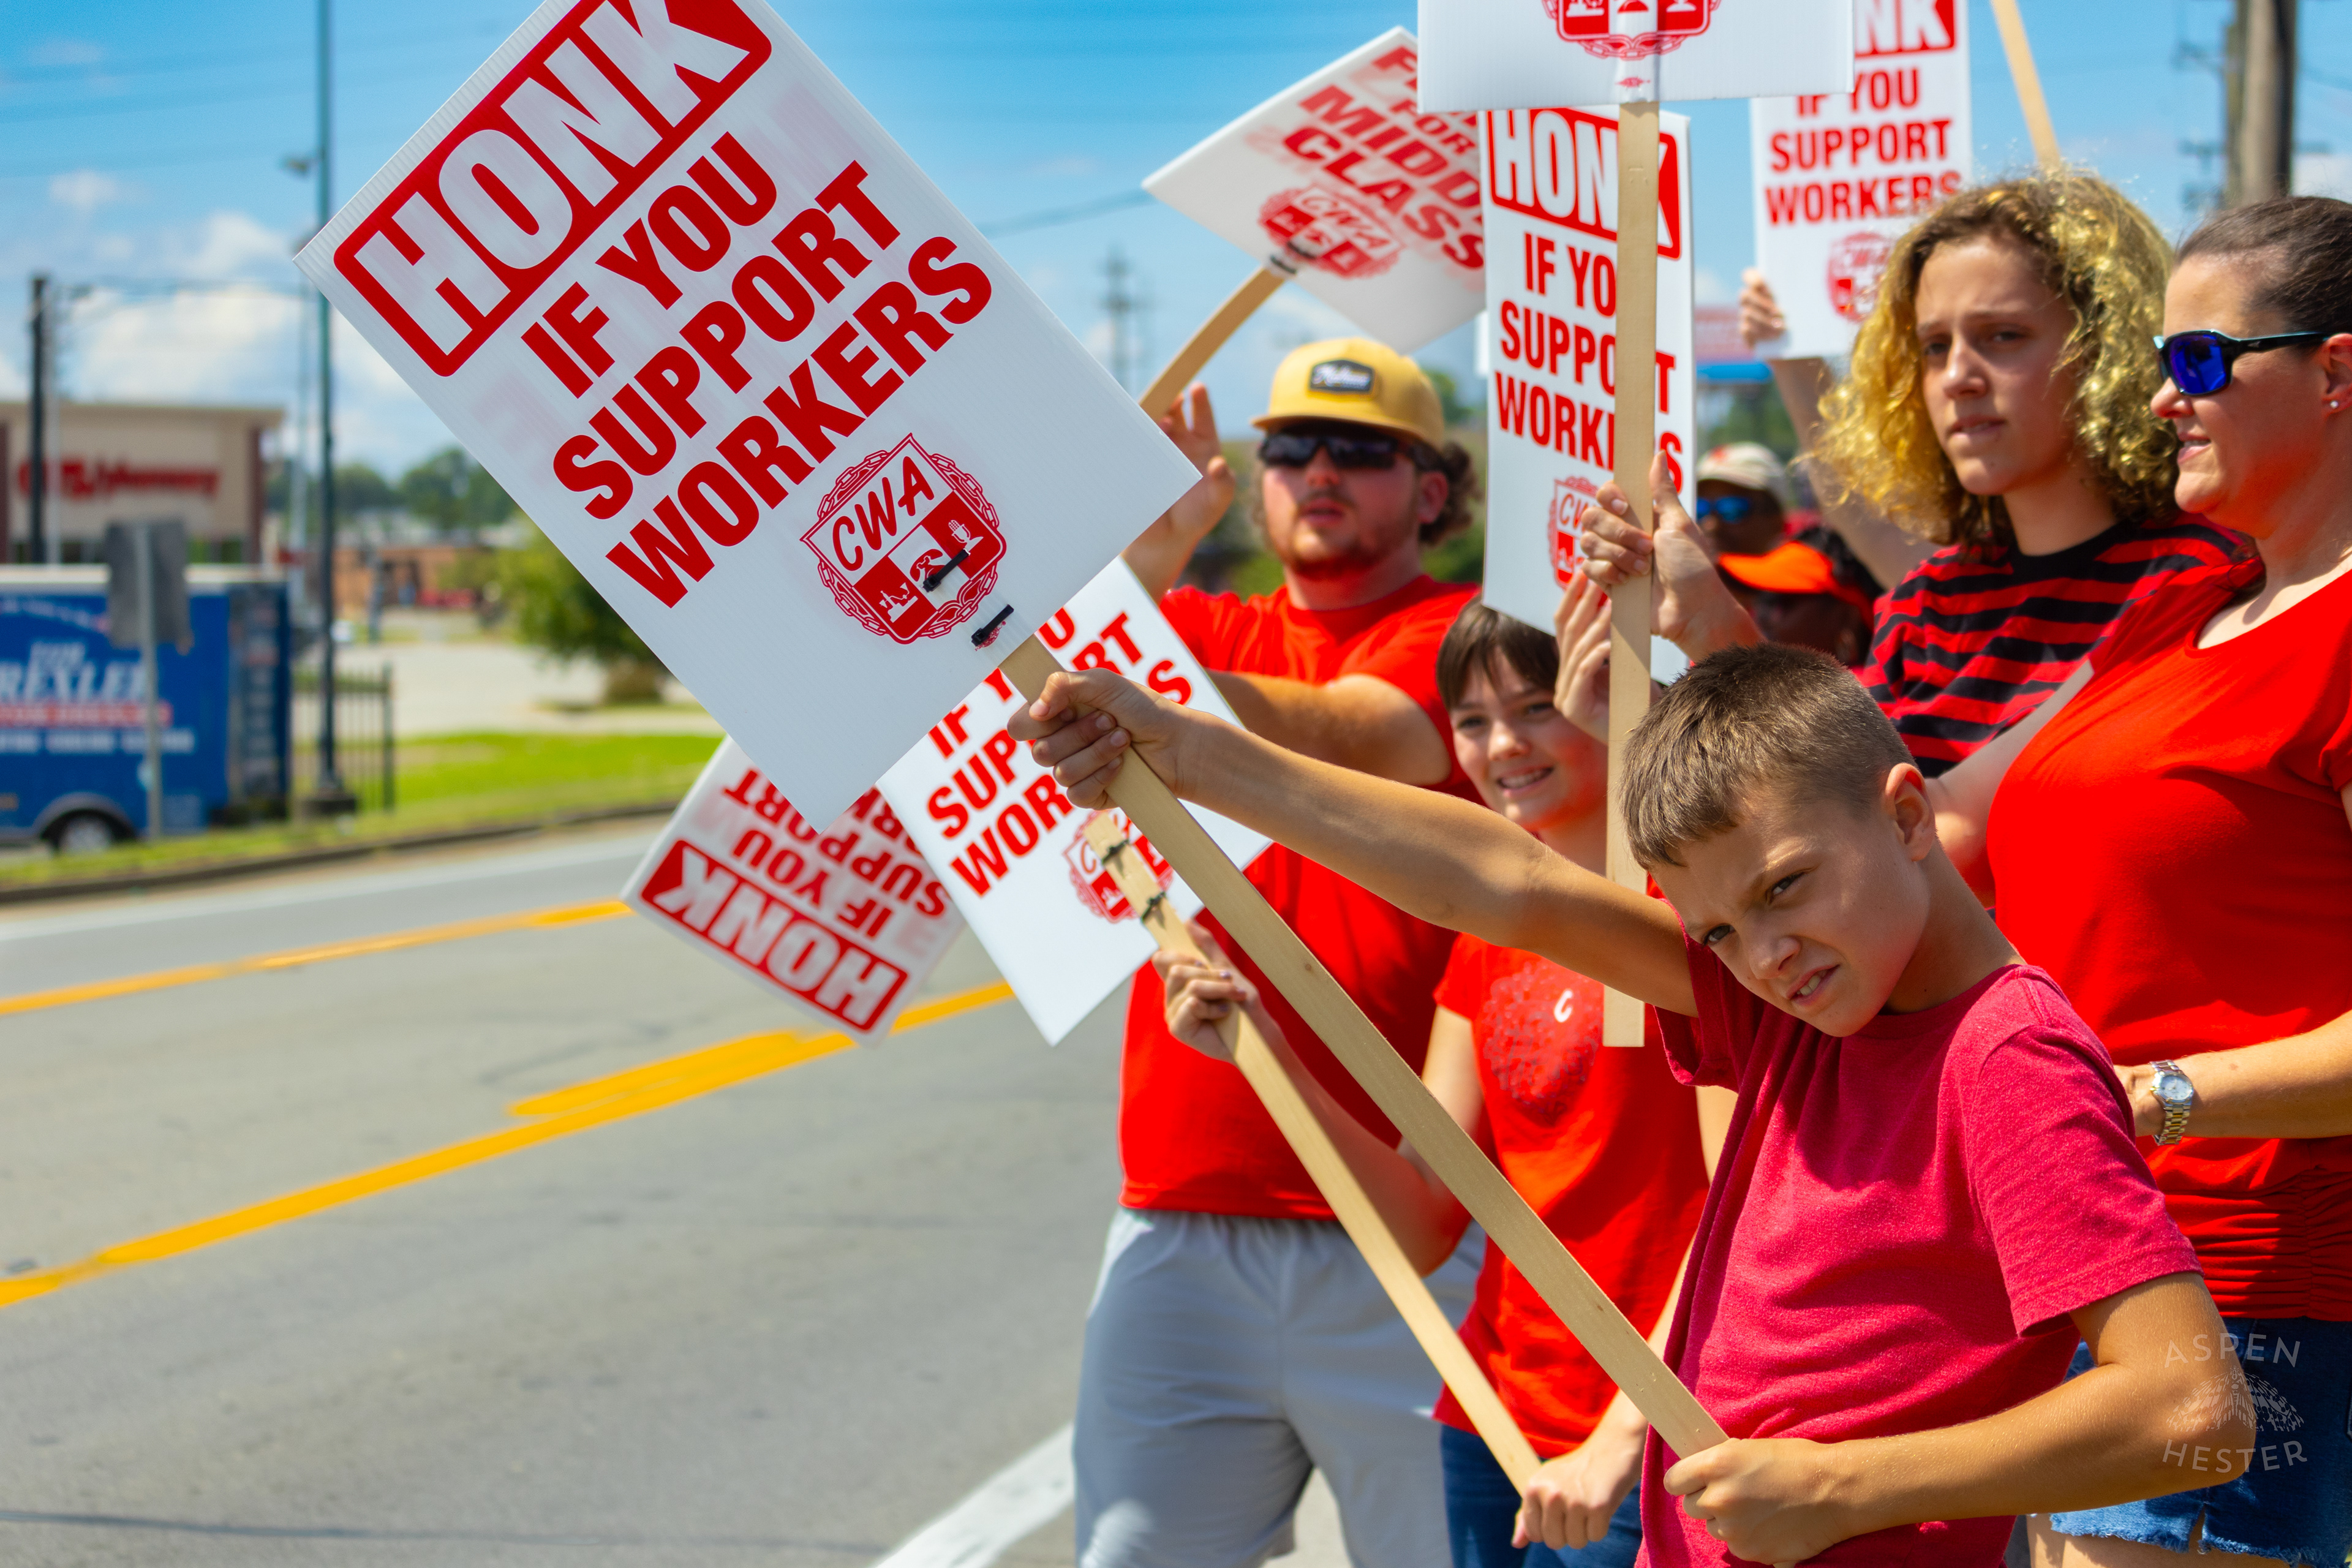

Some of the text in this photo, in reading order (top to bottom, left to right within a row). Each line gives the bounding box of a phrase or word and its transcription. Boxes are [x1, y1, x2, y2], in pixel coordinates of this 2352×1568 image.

[353, 0, 750, 356] HONK
[1282, 127, 1484, 271] CLASS
[1299, 85, 1482, 225] MIDD
[1493, 110, 1673, 247] HON
[1770, 118, 1951, 173] SUPPORT
[521, 131, 777, 399] IF YOU
[1525, 233, 1618, 318] IF YO
[553, 160, 900, 519] SUPPORT
[1501, 300, 1676, 415] SUPPOT
[606, 236, 992, 608] WORKERS
[1495, 372, 1683, 495] WORKS
[832, 456, 934, 571] CWA
[927, 612, 1143, 839] SUPRT
[928, 704, 970, 760] IF
[951, 660, 1193, 897] WORS
[654, 846, 899, 1024] HONK
[733, 829, 892, 938] IF YOU
